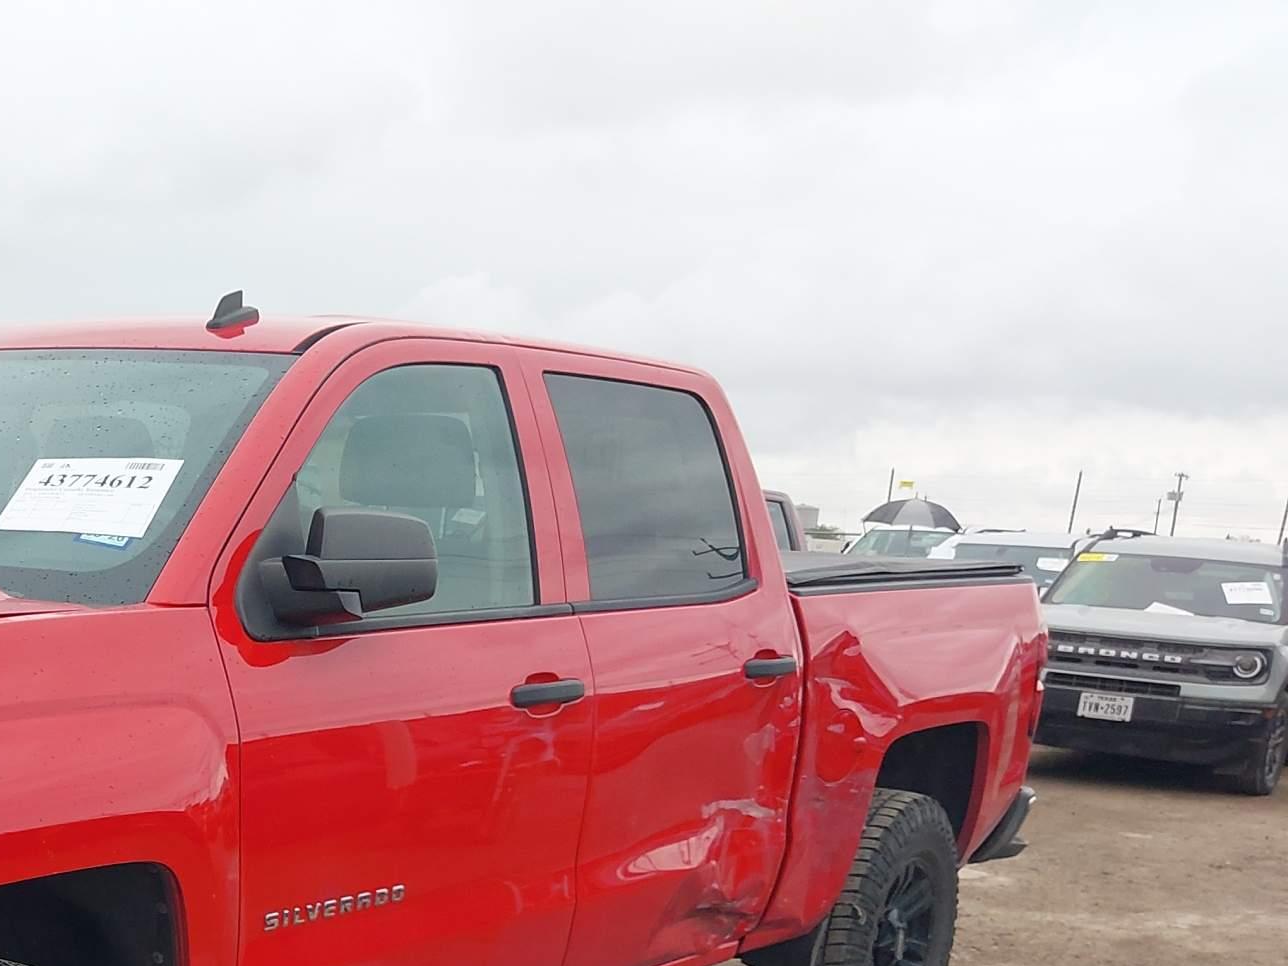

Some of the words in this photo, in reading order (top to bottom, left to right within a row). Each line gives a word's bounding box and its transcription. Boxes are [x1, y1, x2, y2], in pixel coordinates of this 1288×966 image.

[38, 474, 154, 490] 43774612
[1057, 643, 1183, 664] BRONCO
[263, 884, 405, 932] SILVERADO
